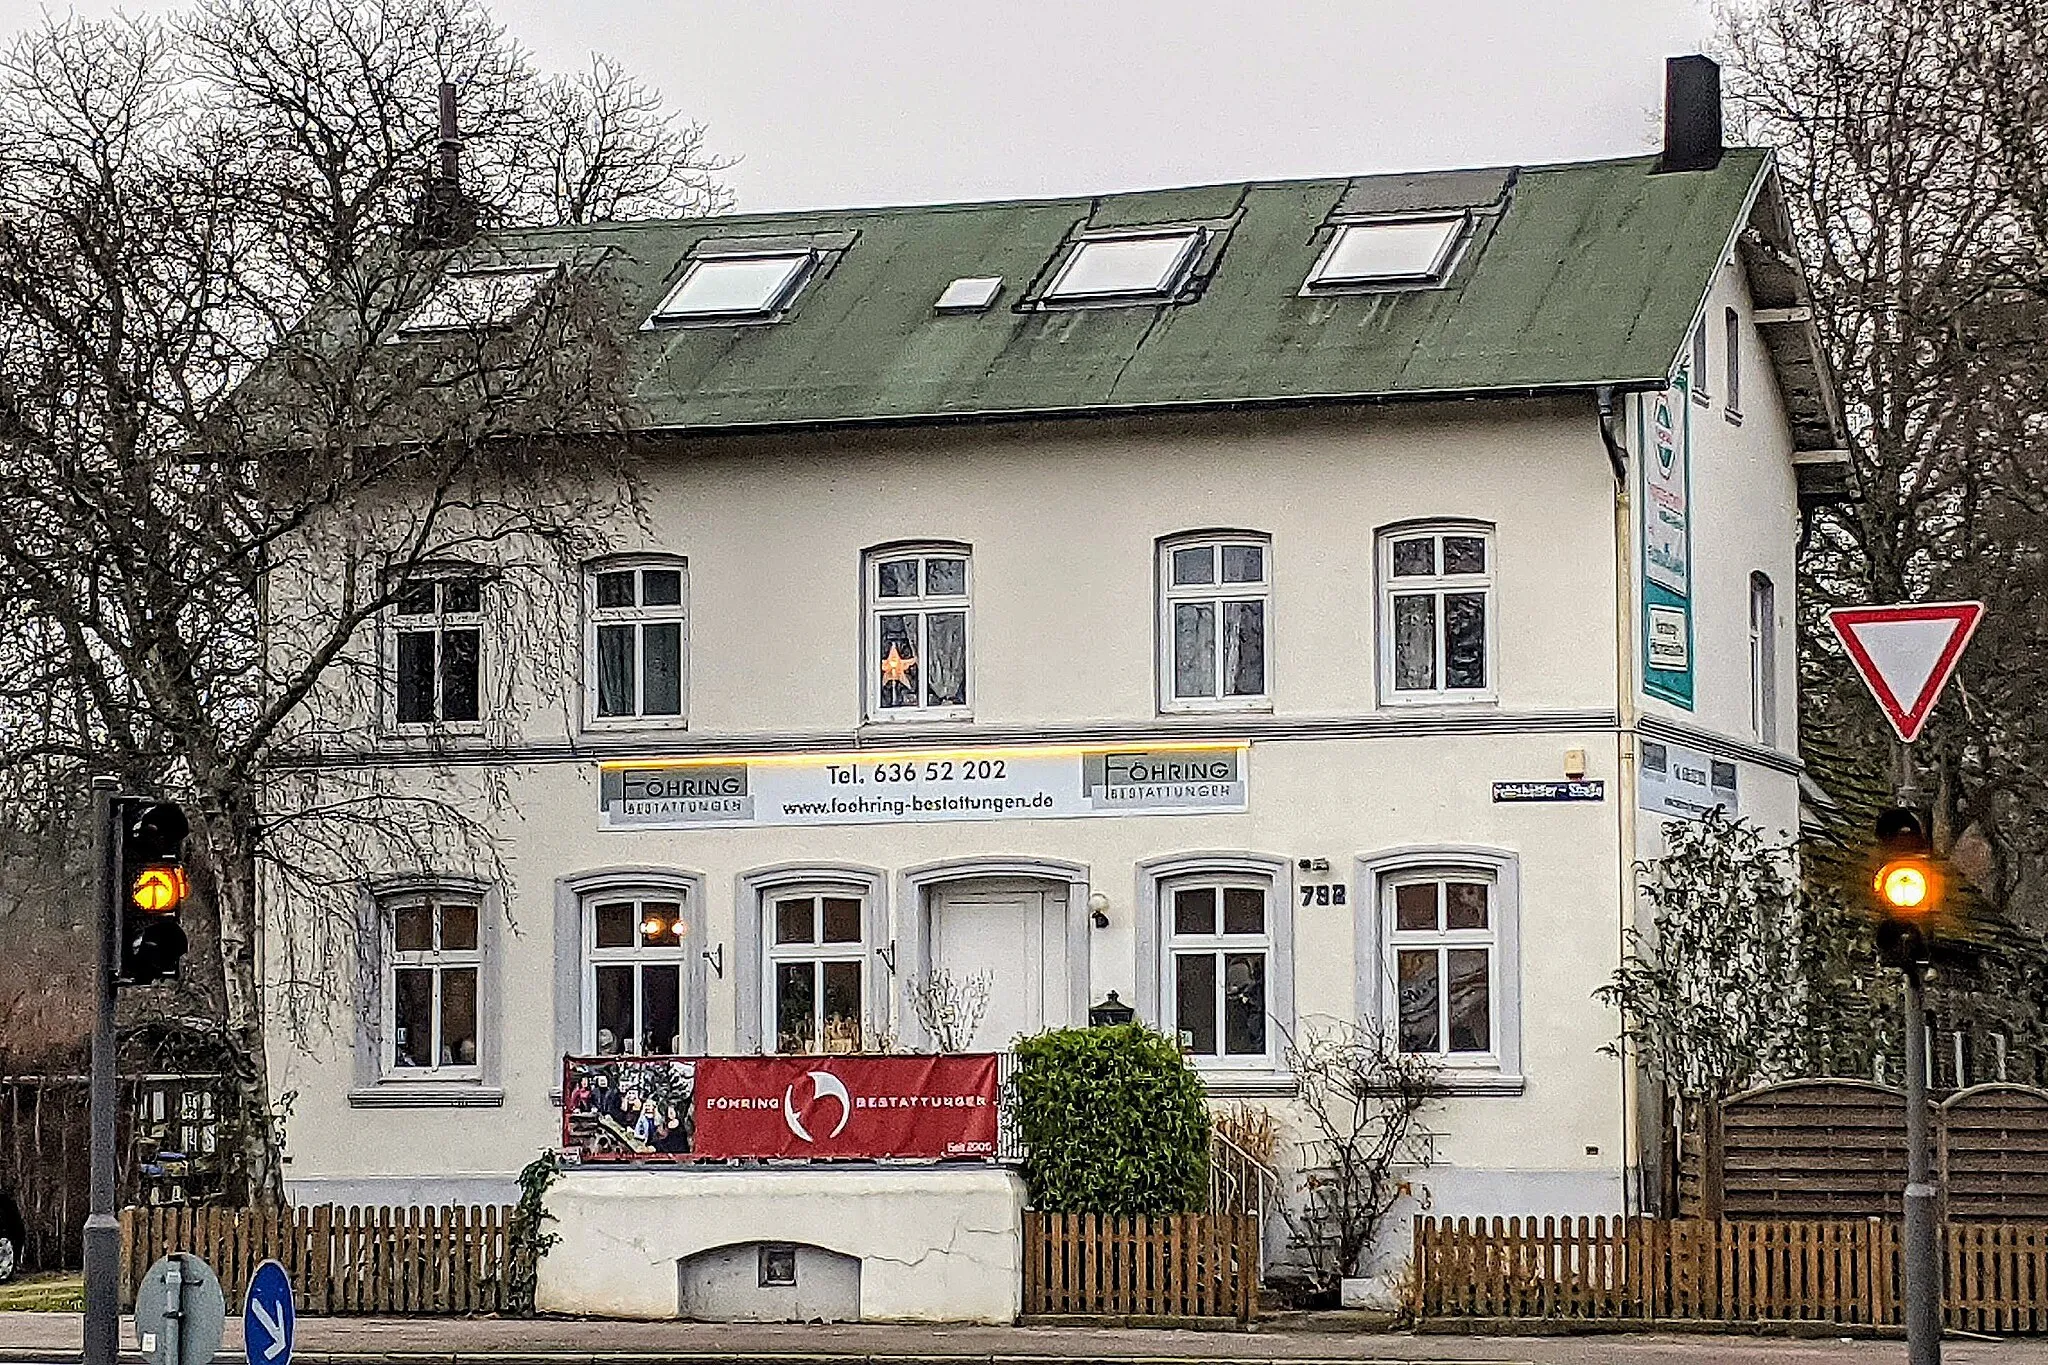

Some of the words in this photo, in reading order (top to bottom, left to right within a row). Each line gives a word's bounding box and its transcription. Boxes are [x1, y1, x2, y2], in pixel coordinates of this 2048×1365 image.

[826, 764, 864, 785] Tel.
[874, 763, 916, 783] 636
[925, 761, 953, 781] 52
[962, 760, 1006, 780] 202
[1105, 753, 1229, 800] FÖHRING
[622, 769, 740, 813] FÖHRING
[783, 792, 1053, 815] www.foehring-bestattungen.de
[706, 1096, 779, 1110] FÖHRING
[856, 1095, 987, 1109] BESTATTUNGEN
